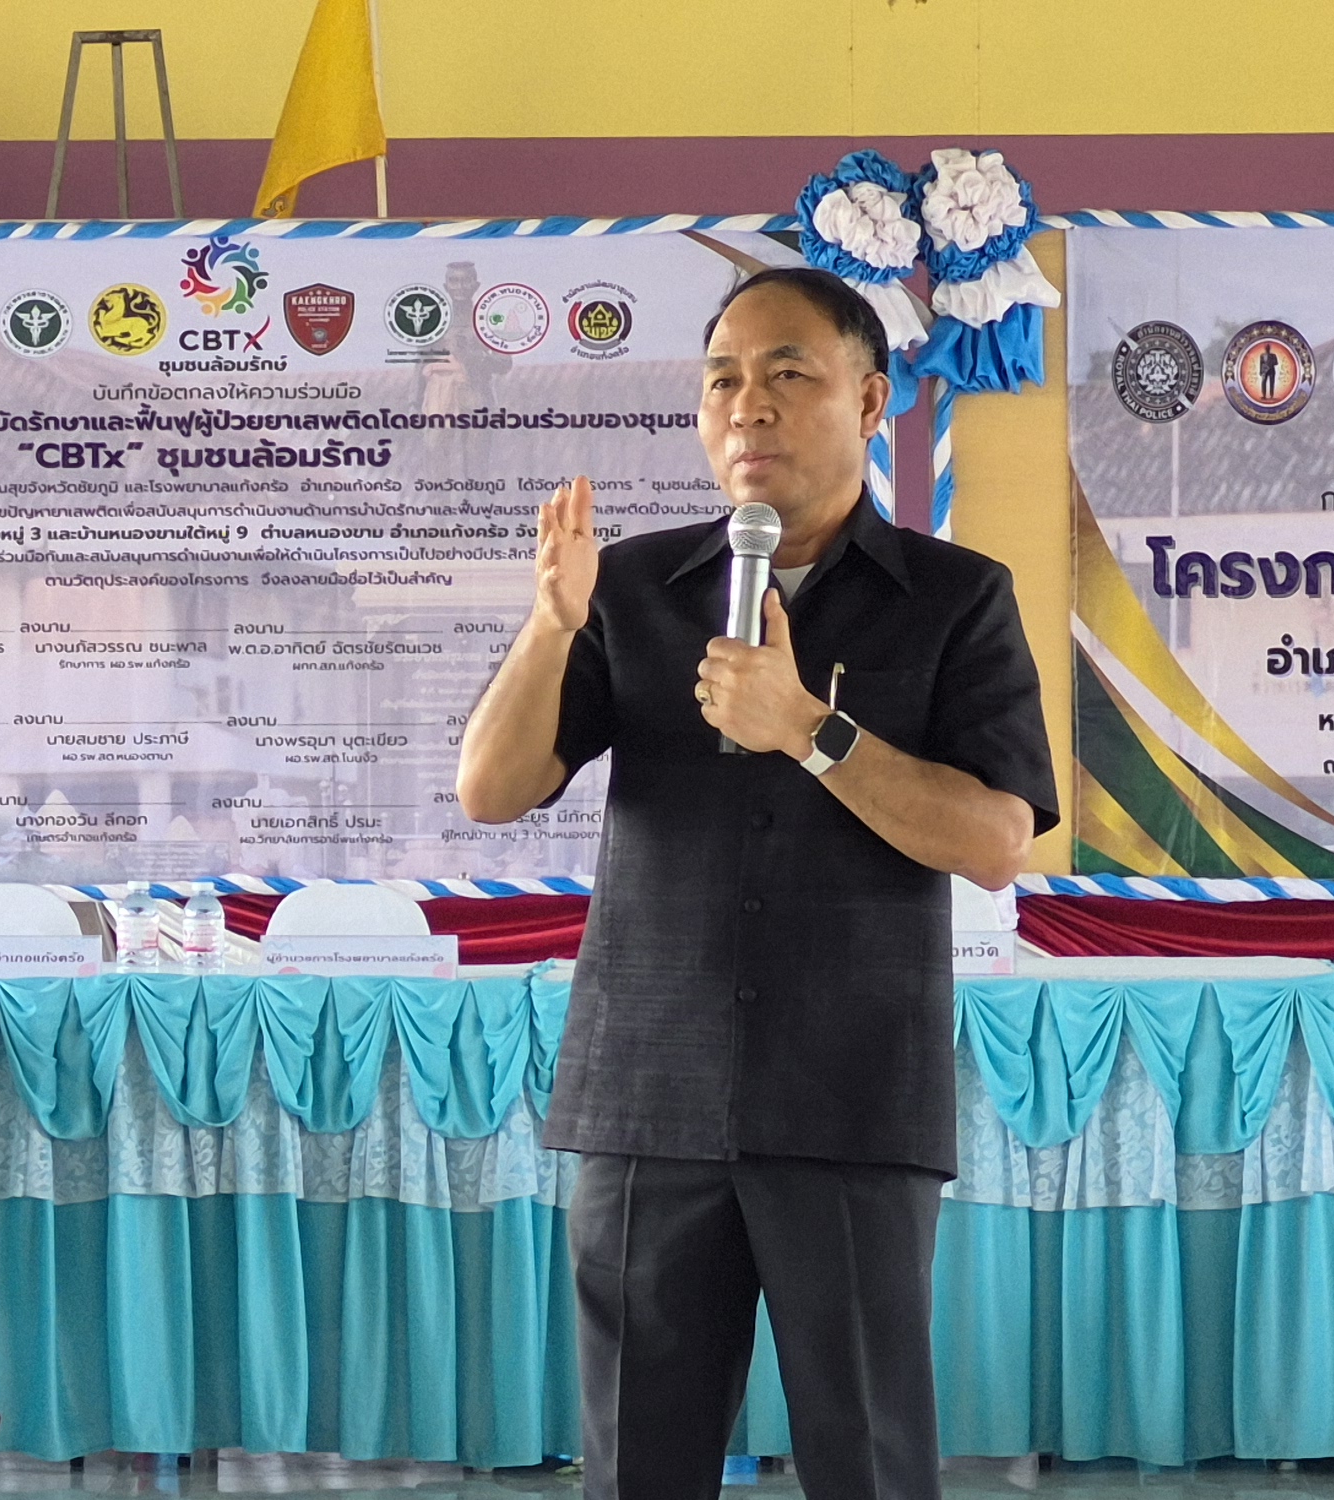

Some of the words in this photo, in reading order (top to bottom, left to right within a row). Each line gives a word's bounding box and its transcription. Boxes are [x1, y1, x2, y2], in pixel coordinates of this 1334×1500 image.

[158, 354, 287, 376] ชุมชนล้อมรักษ์
[92, 382, 362, 402] บันทึกข้อตกลงให้ความร่วมมือ
[1139, 408, 1175, 420] POLICE
[157, 437, 392, 477] ชุมชนล้อมรักษ์
[300, 478, 402, 493] อำเภอแก้งคร้อ
[414, 477, 506, 496] จังหวัดชัยภูมิ
[30, 526, 42, 541] 3
[47, 524, 230, 544] และบ้านหนองขามใต้หมู่
[236, 525, 248, 540] 9
[260, 525, 384, 540] ตำบลหนองขาม
[389, 523, 509, 540] อำเภอแก้งคร้อ
[45, 572, 249, 590] ตามวัตถุประสงค์ของโครงการ
[20, 622, 71, 633] ลงนาม
[234, 623, 284, 634] ลงนาม
[453, 622, 504, 633] ลงนาม
[13, 714, 64, 725] ลงนาม
[226, 715, 277, 727] ลงนาม
[46, 733, 126, 746] นายสมชาย
[211, 797, 262, 808] ลงนาม
[522, 831, 530, 840] 3
